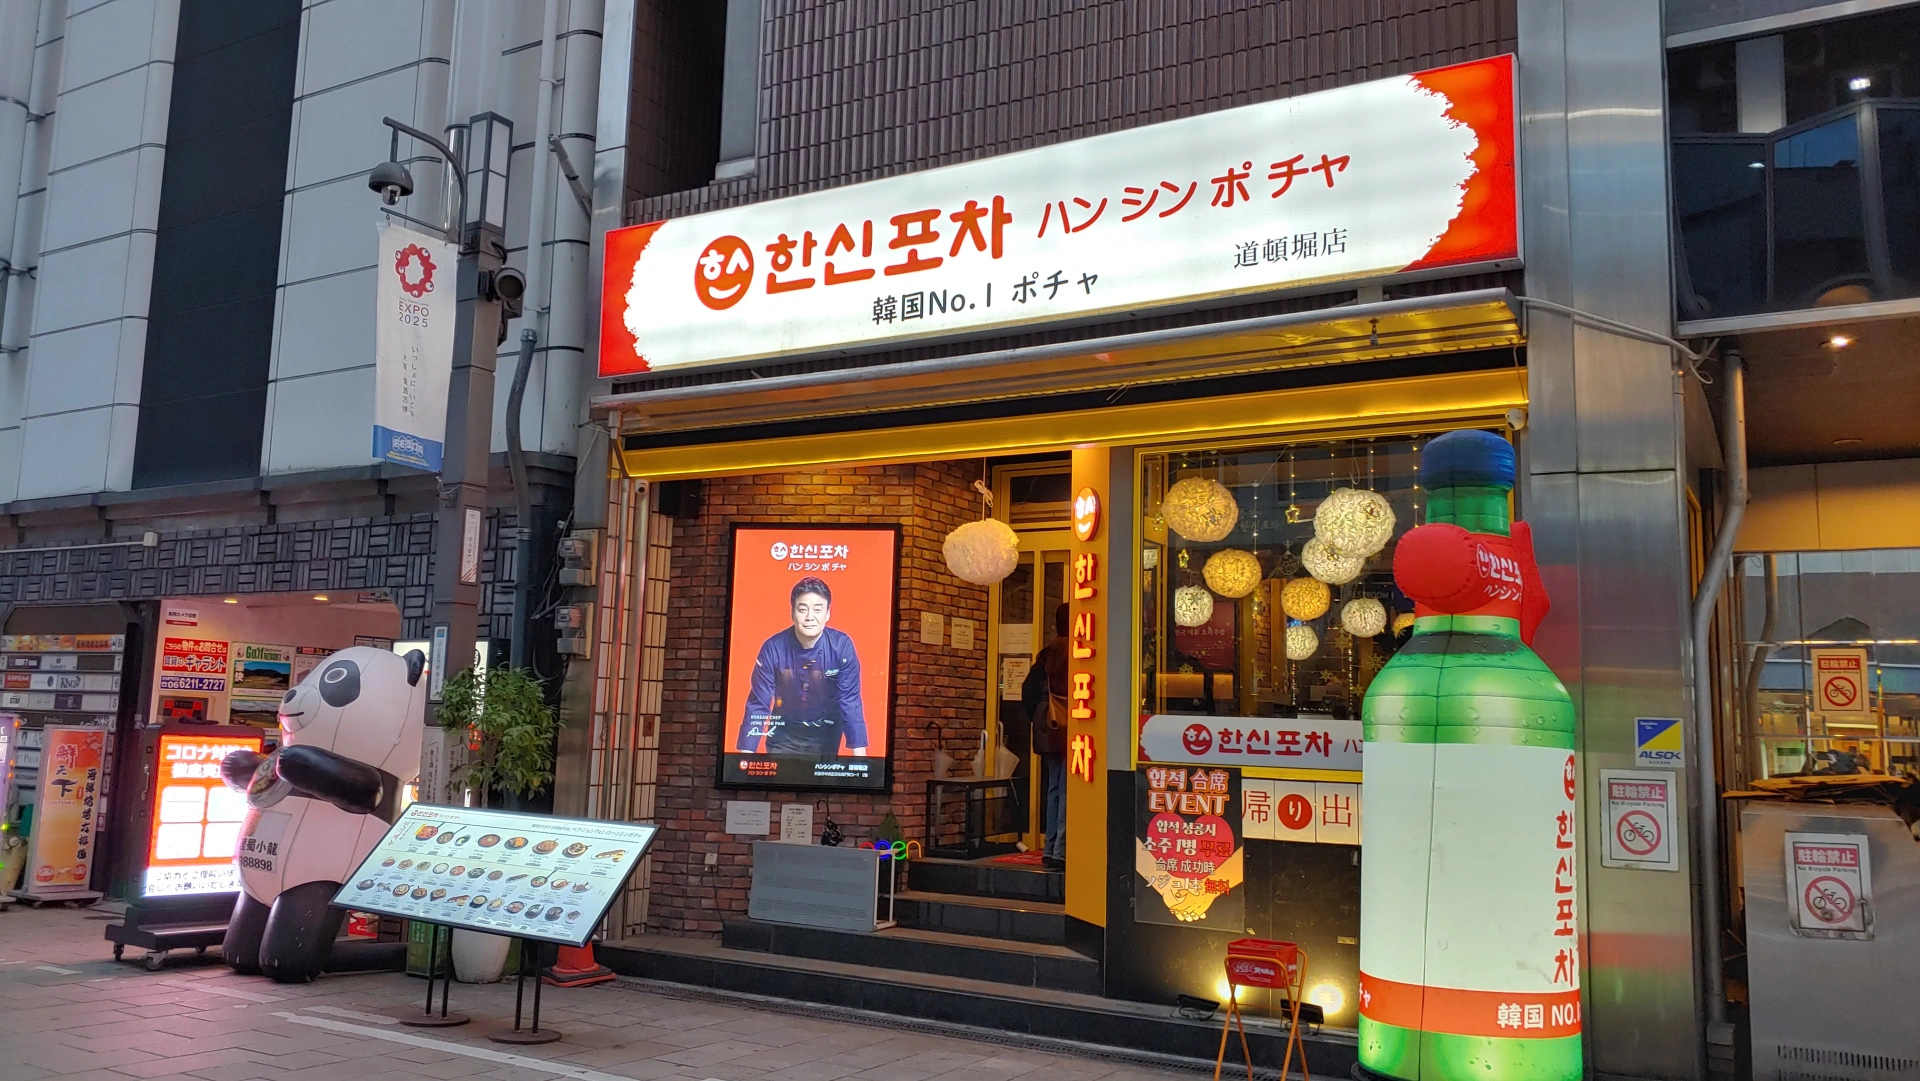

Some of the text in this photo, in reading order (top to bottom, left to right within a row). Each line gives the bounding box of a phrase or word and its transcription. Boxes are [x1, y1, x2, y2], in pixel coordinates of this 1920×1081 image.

[1038, 153, 1350, 239] ハンシンポチャ
[766, 195, 1012, 294] 한신포차
[1234, 228, 1347, 269] 道頓堀店
[1012, 271, 1098, 304] ポチャ
[399, 301, 429, 317] EXPO
[399, 312, 429, 328] 2025
[790, 544, 849, 559] 한신포차
[246, 646, 263, 660] Golf
[1071, 552, 1096, 782] 한신포차
[180, 678, 225, 690] 6211-2727
[1218, 728, 1332, 757] 한신포차
[1639, 751, 1682, 759] ALSOK
[1148, 768, 1229, 792] 합석 合席
[1612, 785, 1664, 799] 駐輪禁止
[1149, 791, 1229, 815] EVENT
[1156, 819, 1216, 836] 합석 성공시
[1143, 836, 1232, 858] 소주 1병 무료
[1798, 849, 1856, 864] 駐輪禁止
[1155, 857, 1216, 874] 合席 成功時
[1204, 877, 1231, 896] 無料
[1554, 810, 1574, 987] 한신포차
[1497, 1003, 1544, 1029] 韓国
